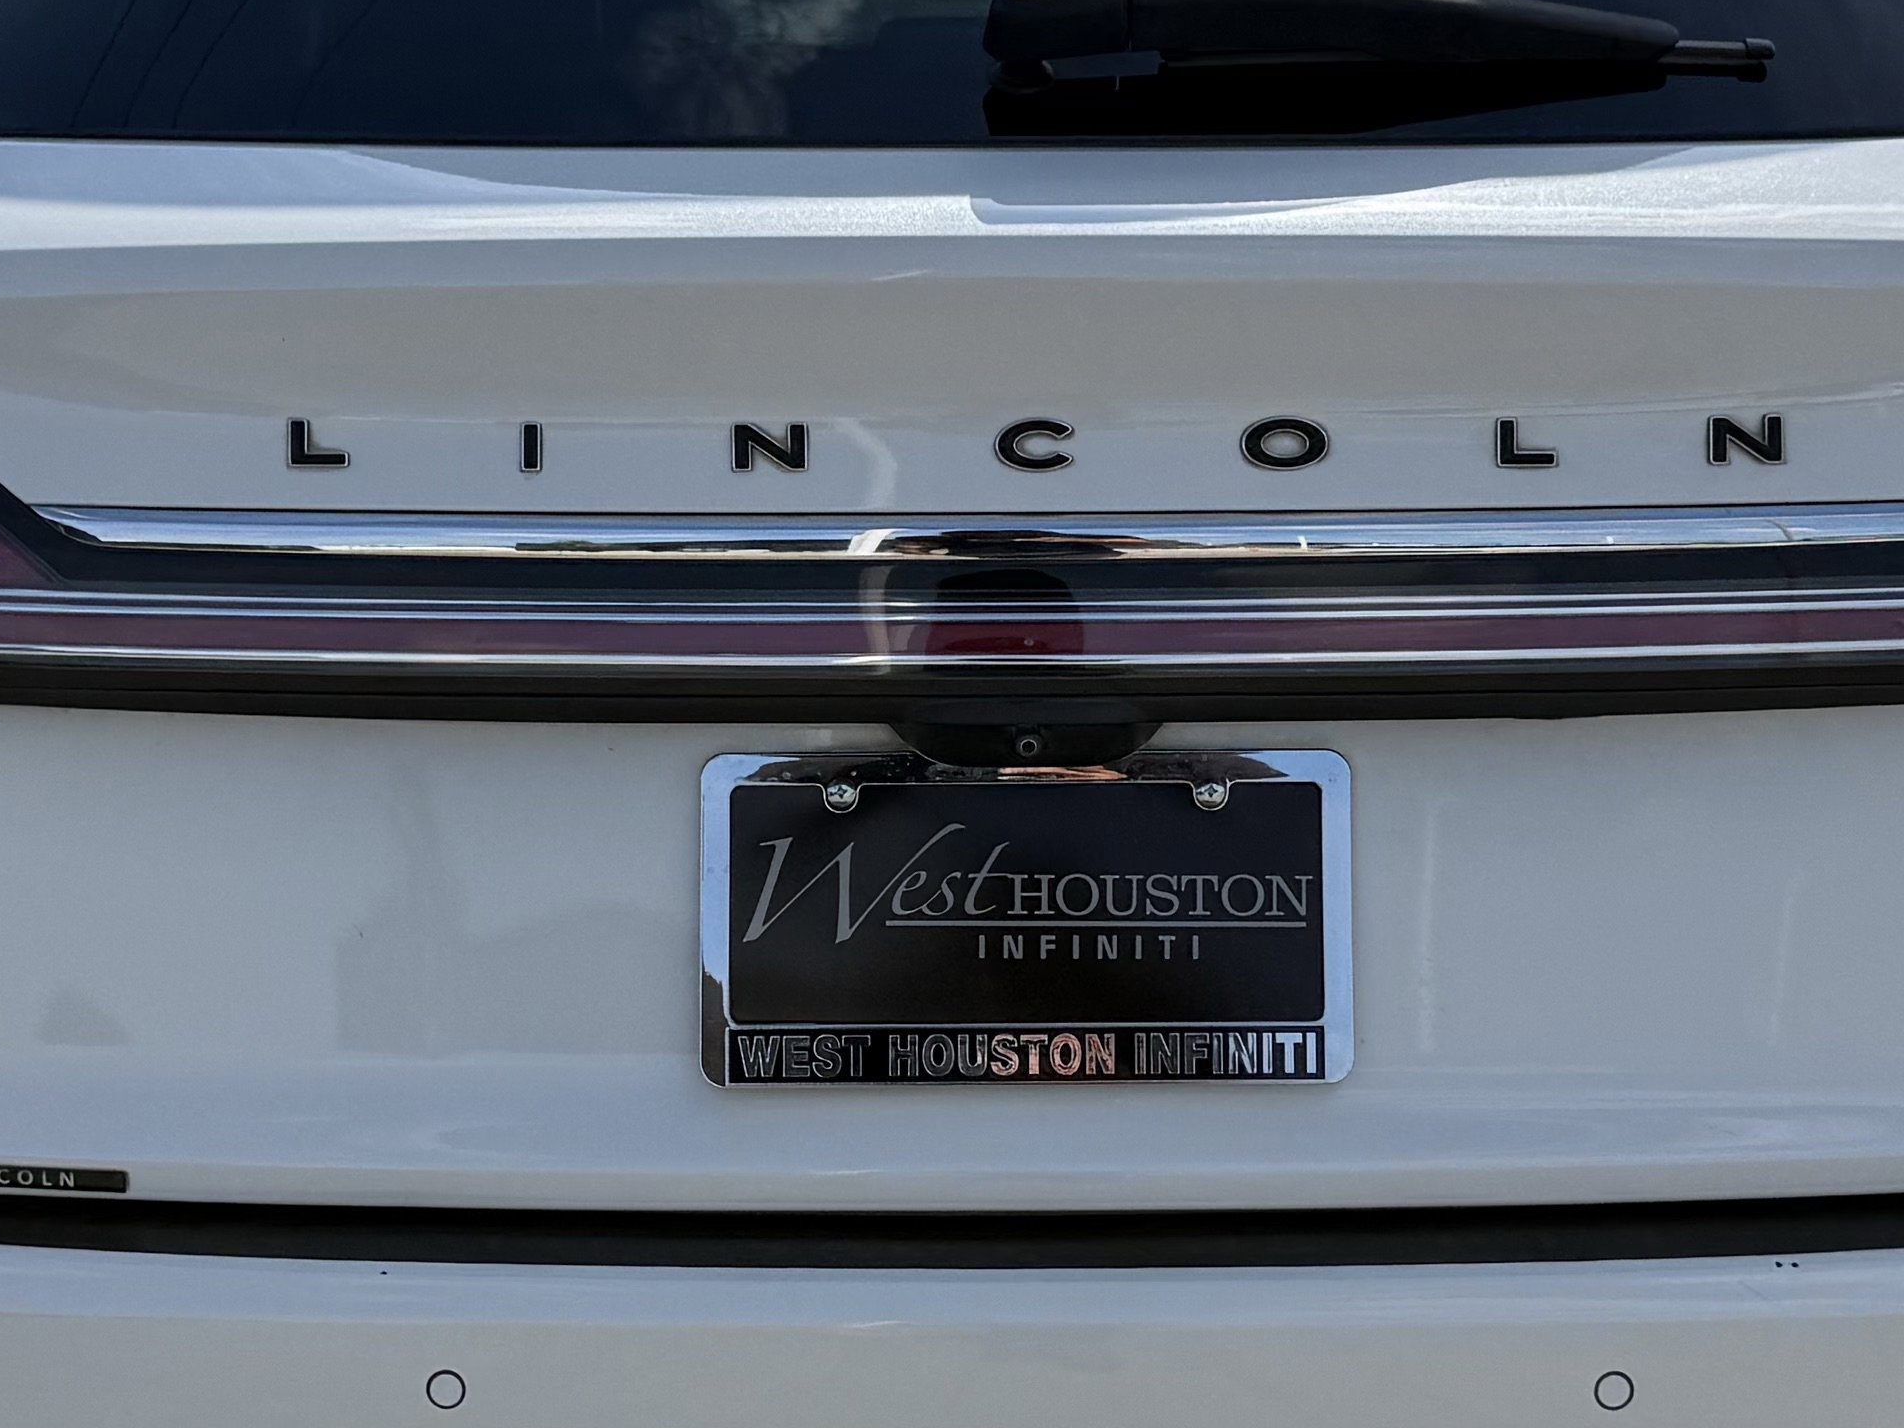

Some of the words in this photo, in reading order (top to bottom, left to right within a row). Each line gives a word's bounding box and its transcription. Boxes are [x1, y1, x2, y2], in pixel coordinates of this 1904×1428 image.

[285, 412, 1789, 472] LINCOLN
[743, 823, 1010, 944] West
[1008, 873, 1313, 916] HOUSTON
[978, 934, 1201, 960] INFINITI
[738, 1035, 871, 1078] WEST
[889, 1035, 1115, 1076] HOUSTON
[1135, 1033, 1317, 1076] INFINITI
